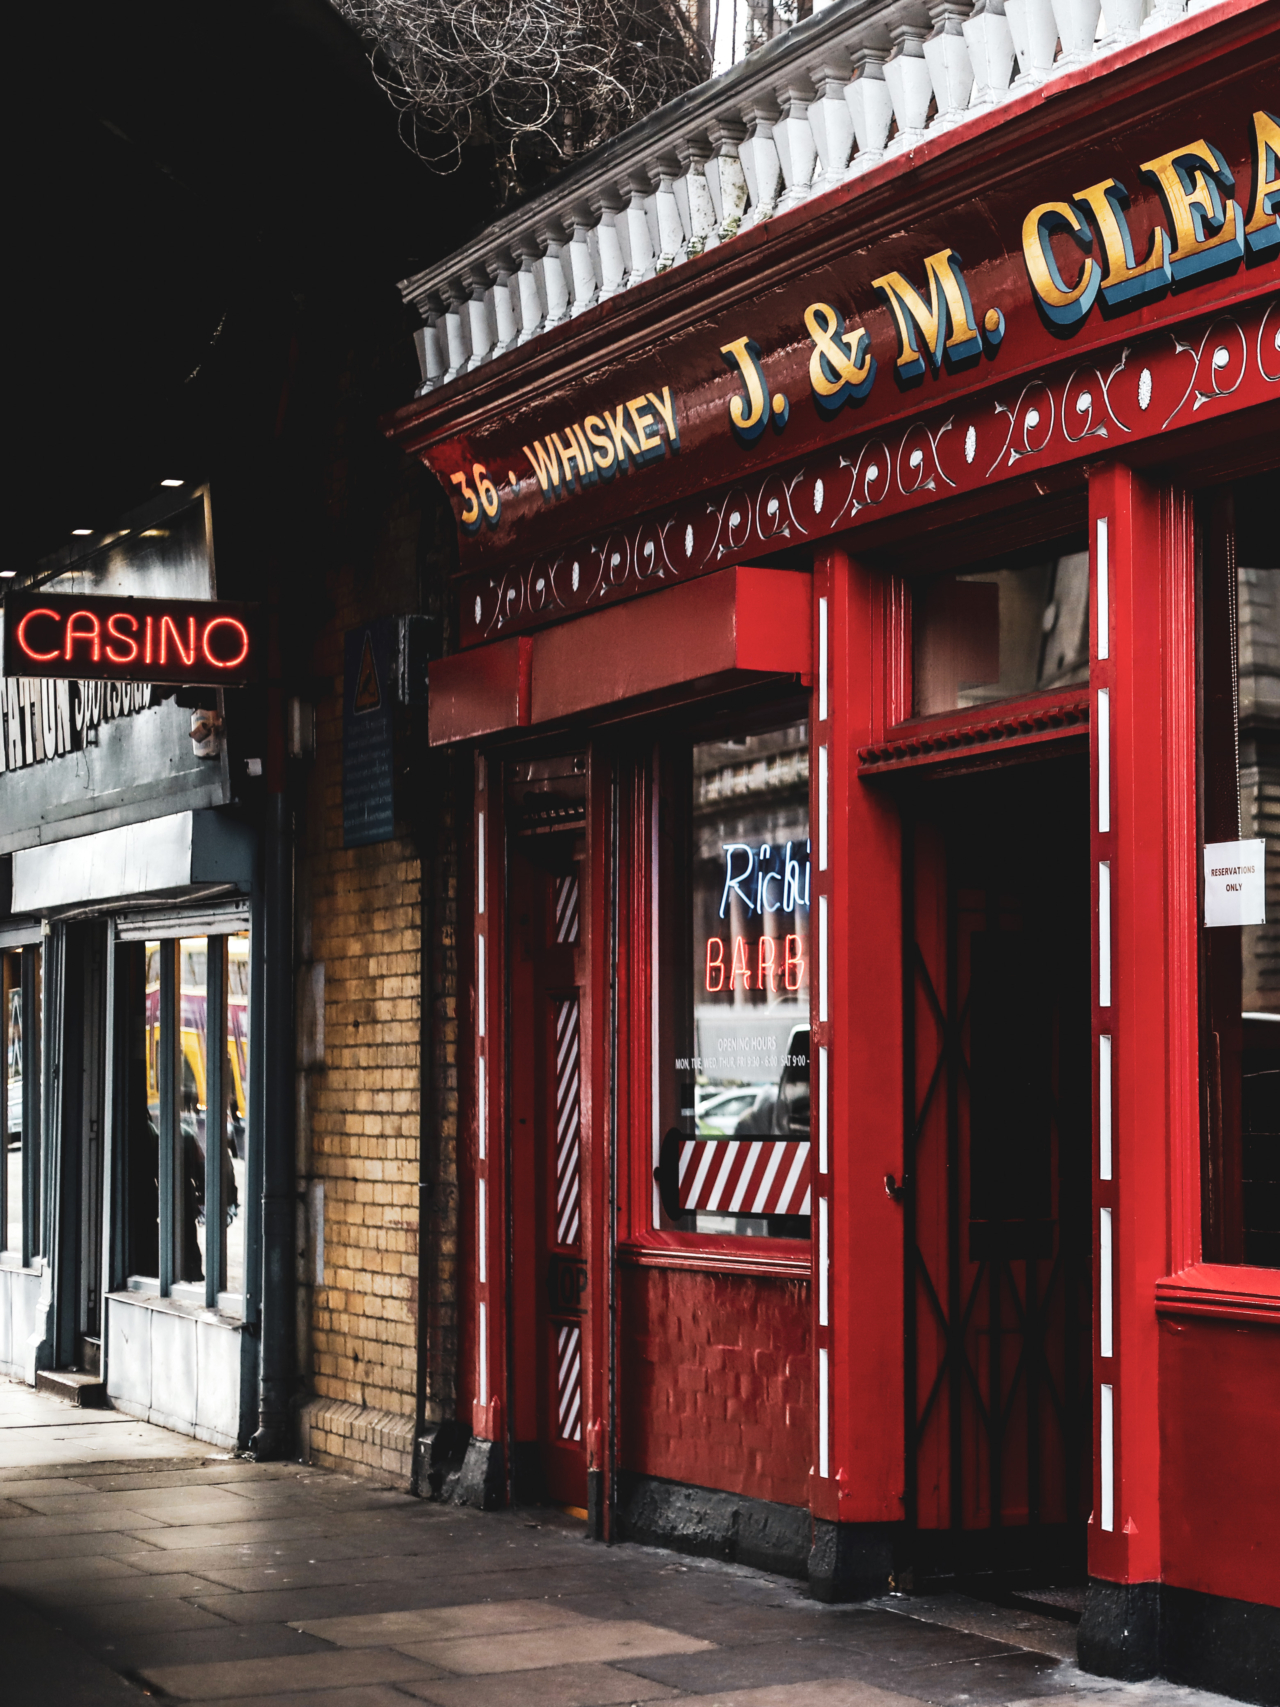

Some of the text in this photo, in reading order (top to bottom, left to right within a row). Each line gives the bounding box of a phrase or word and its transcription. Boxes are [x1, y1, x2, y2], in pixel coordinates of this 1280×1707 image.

[450, 463, 501, 528] 36
[522, 386, 680, 500] WHISKEY
[720, 336, 789, 437] J.
[804, 302, 877, 408] &
[871, 248, 1005, 380] M.
[17, 607, 249, 667] CASINO
[1211, 866, 1255, 876] RESERVATIONS
[1225, 884, 1242, 892] ONLY
[717, 1035, 777, 1051] OPENING HOURS
